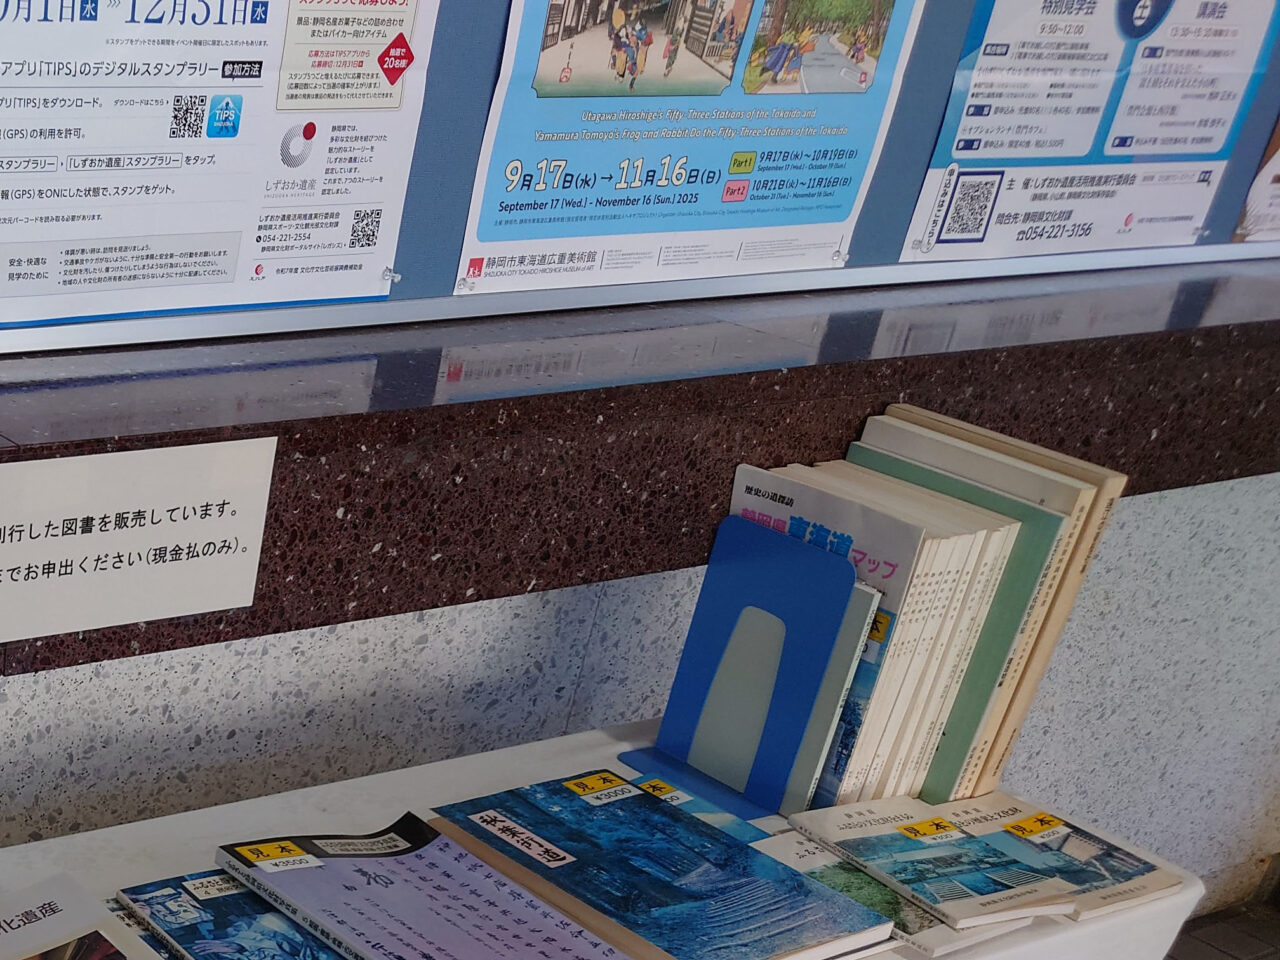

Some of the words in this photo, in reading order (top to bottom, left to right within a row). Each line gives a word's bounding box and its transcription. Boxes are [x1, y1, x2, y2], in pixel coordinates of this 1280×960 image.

[223, 62, 262, 77] 参加方法
[215, 110, 236, 121] TIPS
[265, 178, 317, 192] しずおか遺産
[498, 200, 549, 214] September
[595, 195, 641, 207] November
[676, 192, 699, 204] 2025
[262, 233, 312, 243] 054-221-2554
[1024, 222, 1094, 241] 054-221-3156
[485, 250, 598, 269] 静岡市東海道広重美術館
[7, 271, 49, 282] 見学のために
[572, 774, 618, 792] 見本
[904, 820, 953, 838] 見本
[1017, 813, 1056, 836] 見本
[249, 843, 297, 859] 見本
